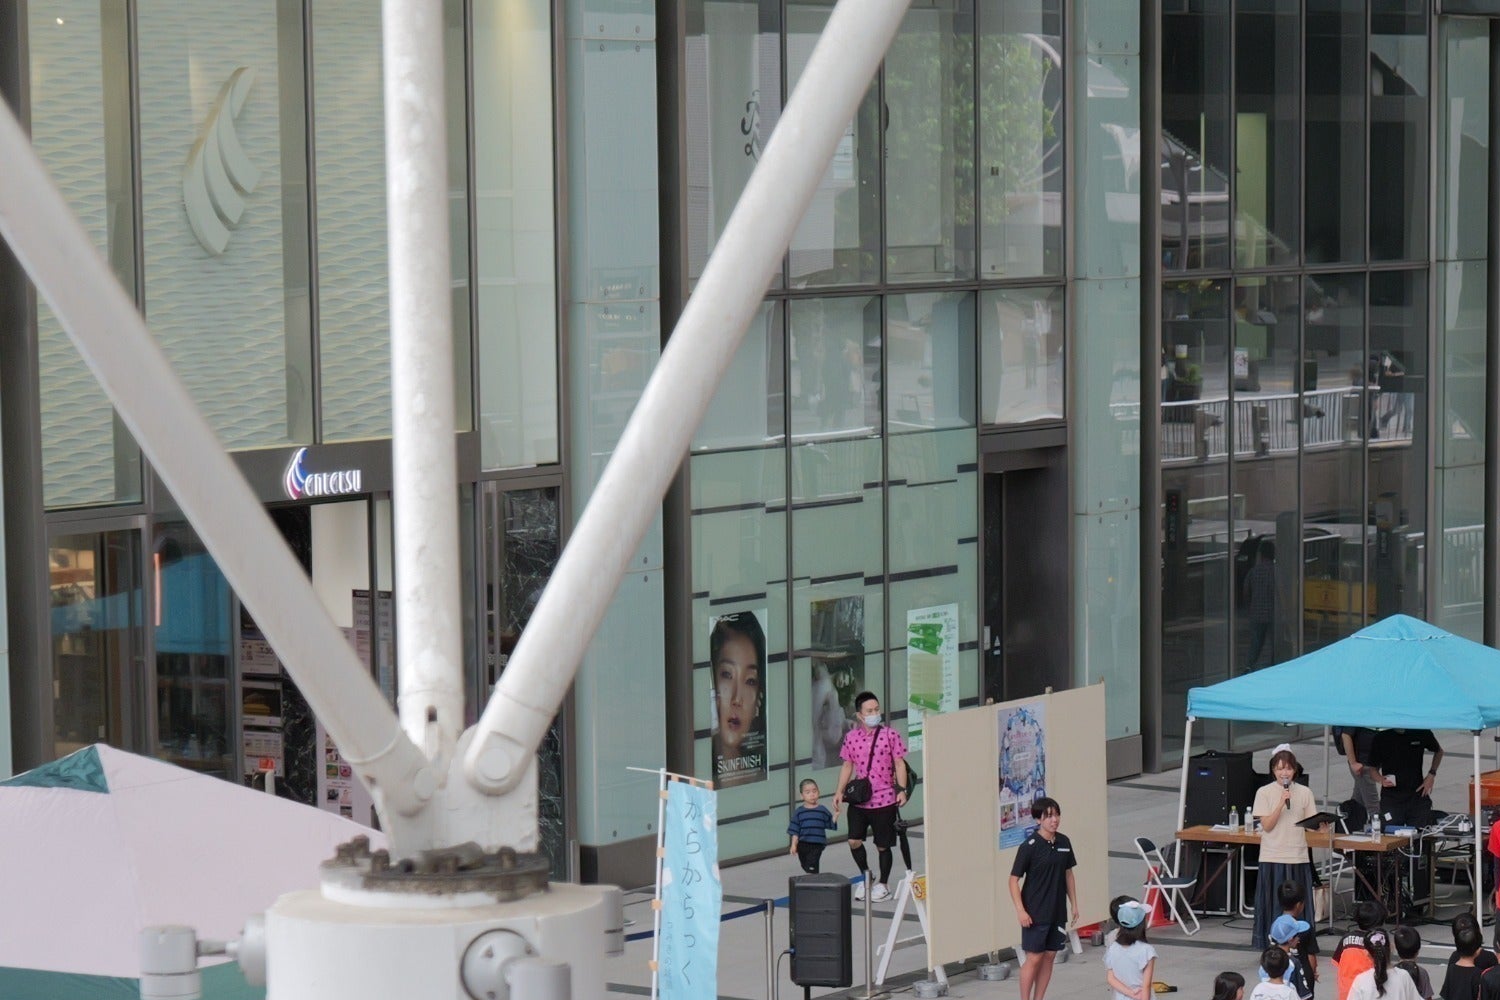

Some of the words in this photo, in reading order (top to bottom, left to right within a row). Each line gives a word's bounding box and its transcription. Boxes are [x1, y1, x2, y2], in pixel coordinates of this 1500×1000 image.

[717, 754, 762, 774] SKINFINISH
[681, 799, 703, 986] からからっく
